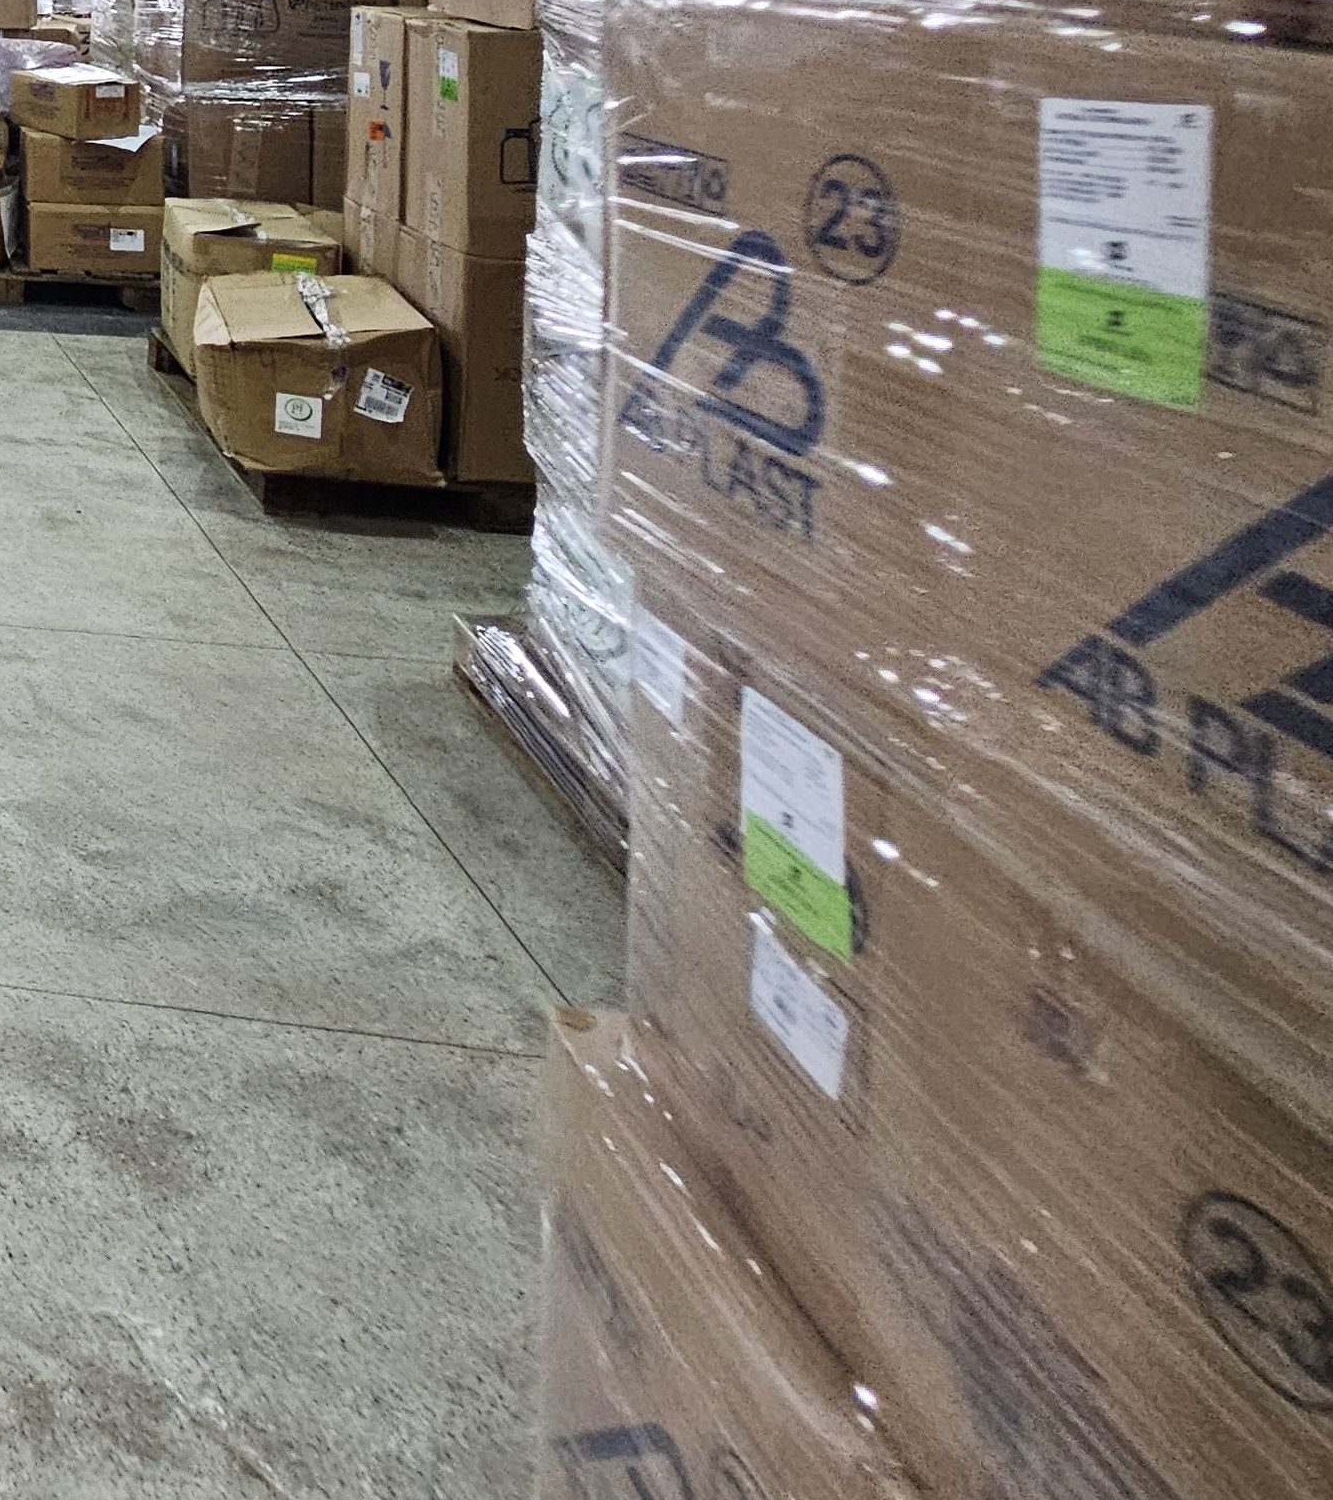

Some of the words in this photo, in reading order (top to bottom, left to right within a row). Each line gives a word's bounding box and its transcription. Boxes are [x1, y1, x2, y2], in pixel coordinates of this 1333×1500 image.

[813, 178, 890, 260] 23
[1037, 634, 1160, 757] AB
[1186, 698, 1333, 874] PL
